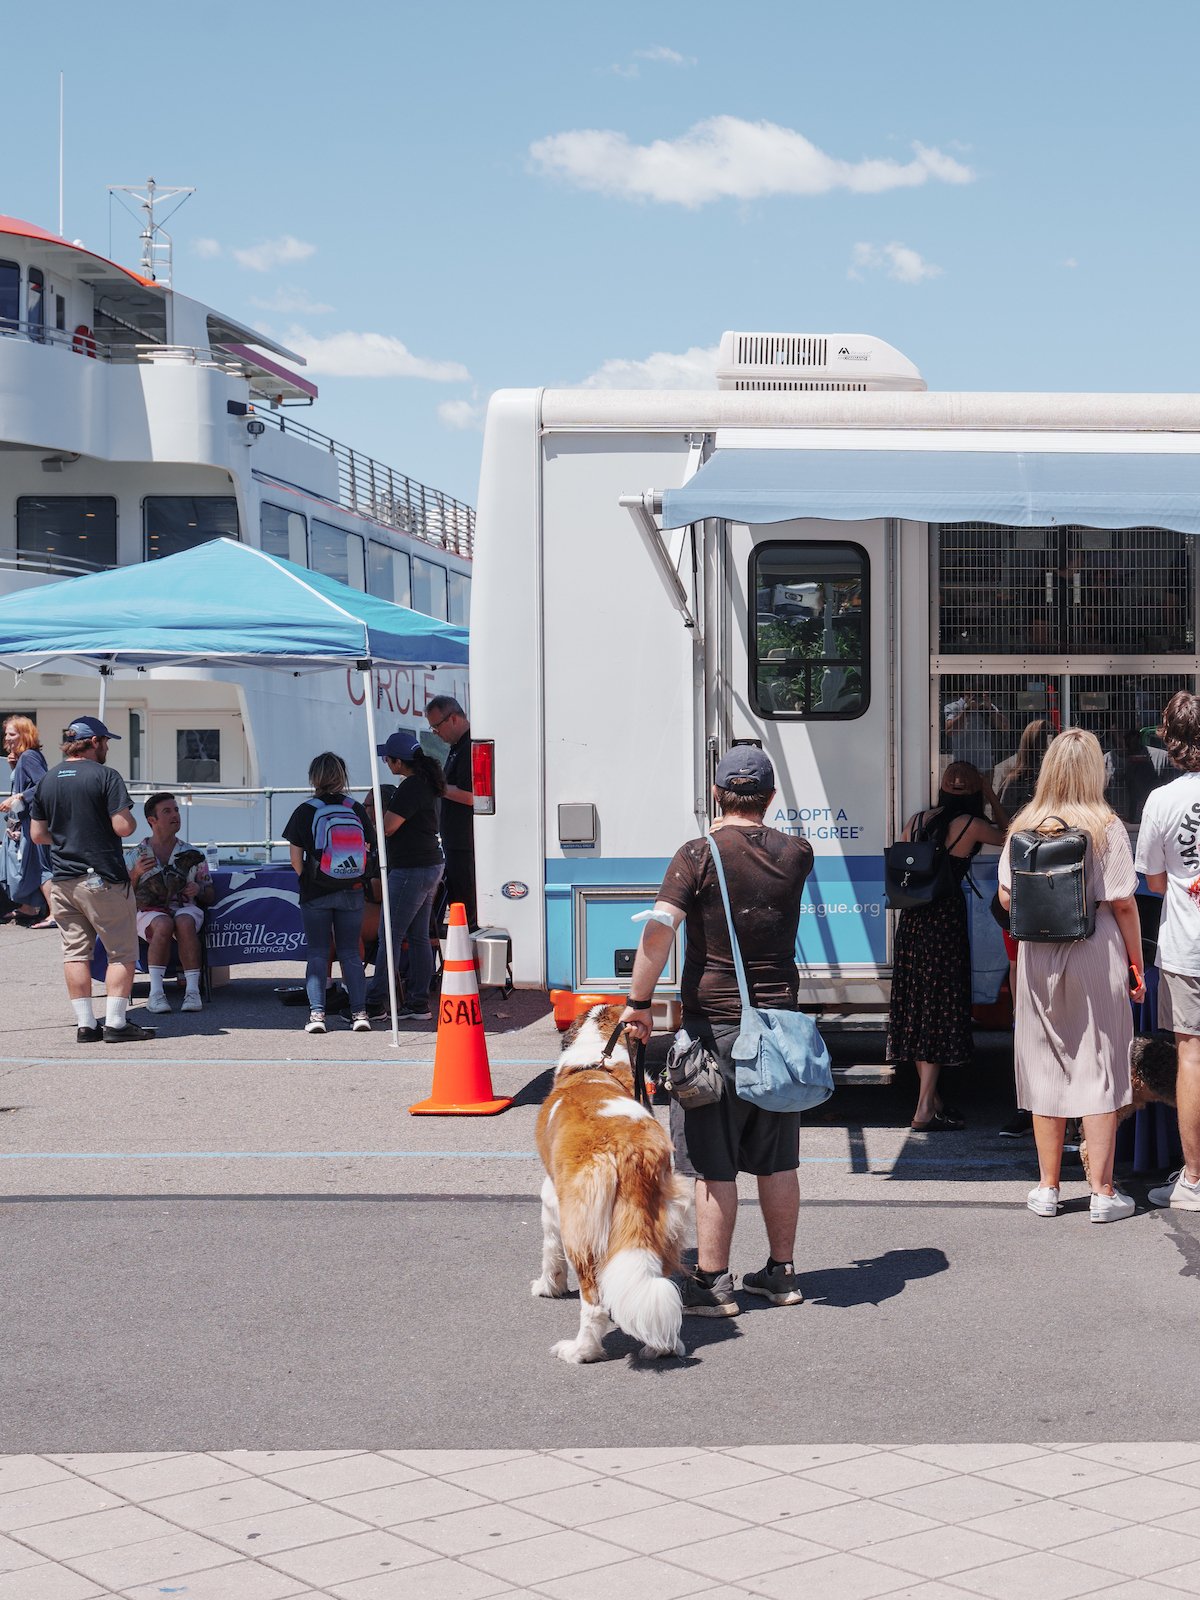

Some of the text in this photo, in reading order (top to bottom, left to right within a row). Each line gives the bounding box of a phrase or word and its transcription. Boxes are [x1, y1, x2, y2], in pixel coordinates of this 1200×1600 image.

[774, 808, 848, 821] ADOPT A
[333, 867, 360, 875] adidas
[799, 902, 881, 918] eague.org
[223, 920, 253, 931] shore
